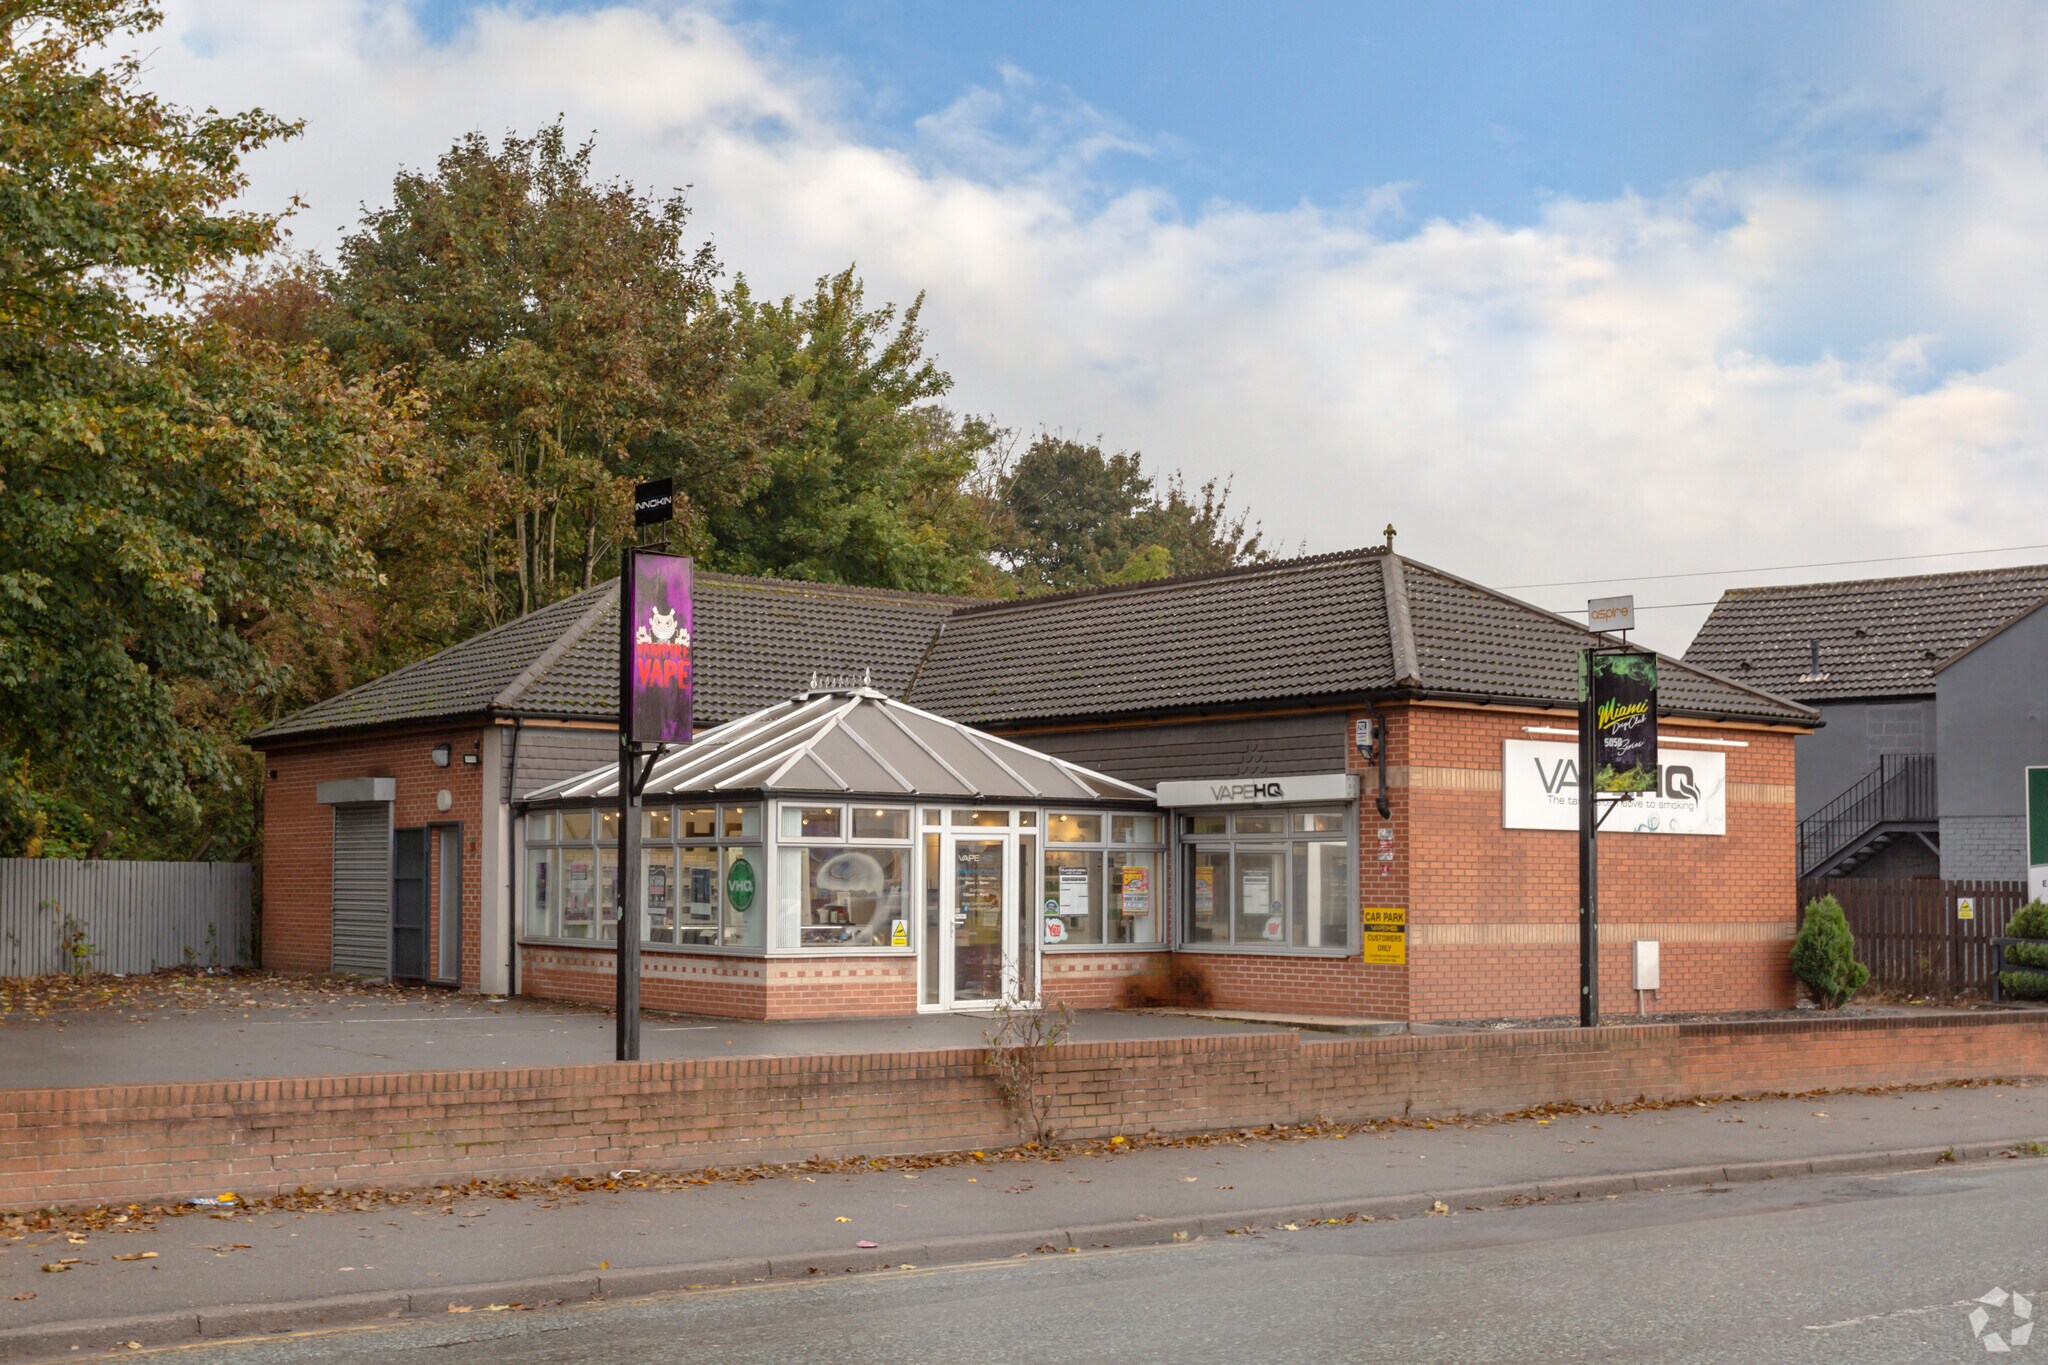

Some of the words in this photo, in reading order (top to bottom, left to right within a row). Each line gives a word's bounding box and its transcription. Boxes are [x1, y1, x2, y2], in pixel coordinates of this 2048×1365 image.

[1591, 607, 1628, 622] aspire
[637, 642, 689, 661] VAMPIRE
[638, 657, 691, 689] VAPE
[1598, 697, 1649, 730] Miami
[1604, 737, 1622, 747] 5050
[1210, 782, 1285, 800] VAPEHQ
[1547, 794, 1565, 805] The
[1658, 802, 1694, 812] smoking
[728, 879, 753, 892] VHQ
[1365, 912, 1381, 921] CAR
[1383, 912, 1404, 922] PARK
[1367, 934, 1402, 942] CUSTOMERS
